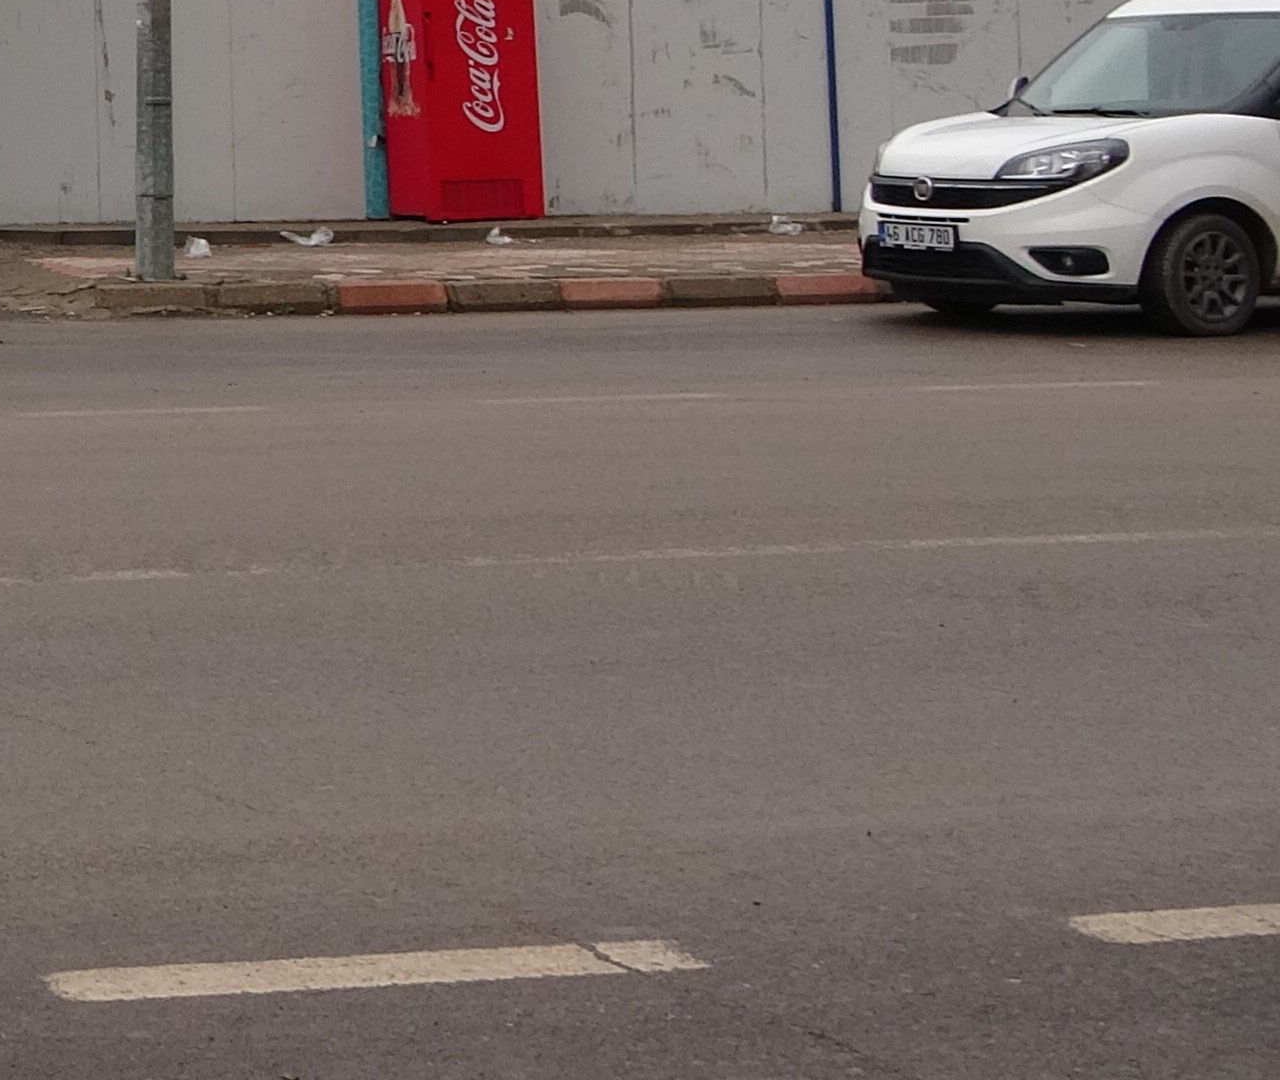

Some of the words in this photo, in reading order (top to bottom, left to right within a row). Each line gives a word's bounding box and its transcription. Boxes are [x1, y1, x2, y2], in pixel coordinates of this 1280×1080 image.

[886, 225, 900, 241] 46
[905, 226, 925, 243] ACG
[929, 228, 950, 245] 780
